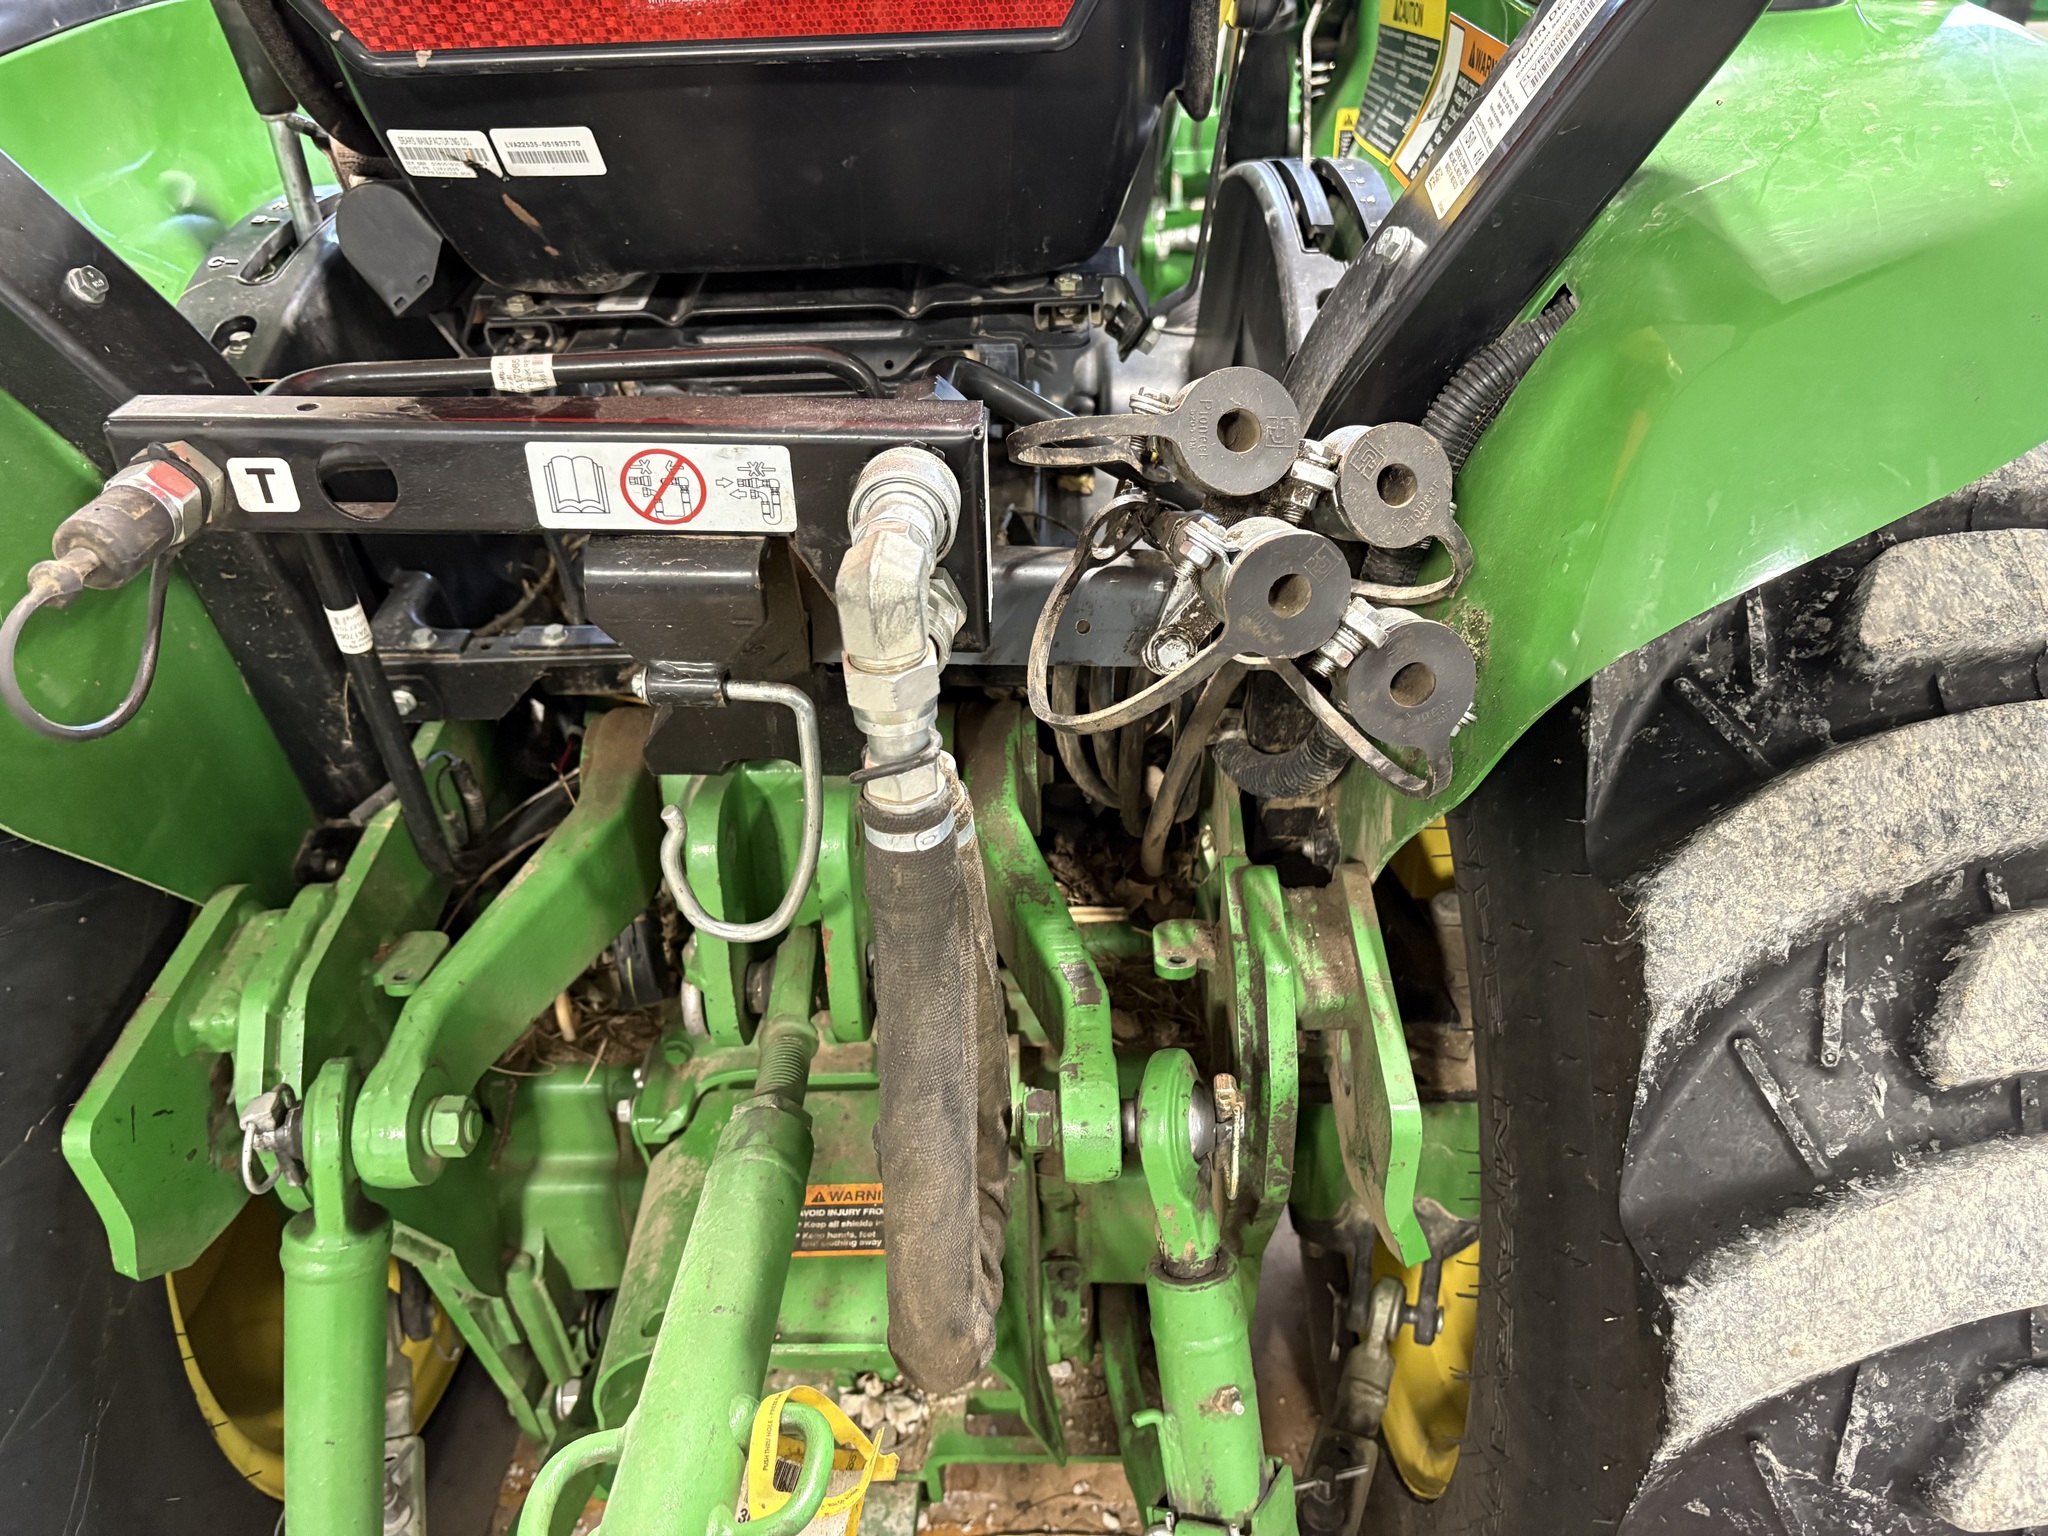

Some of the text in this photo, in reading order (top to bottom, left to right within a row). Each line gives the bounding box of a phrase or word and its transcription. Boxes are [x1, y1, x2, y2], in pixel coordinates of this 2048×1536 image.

[1516, 24, 1546, 69] JOHN
[1198, 399, 1213, 462] Pioneer
[244, 467, 276, 503] T
[1400, 480, 1441, 532] Pioneer
[827, 1208, 861, 1217] INJURY
[804, 1221, 826, 1229] Keep
[828, 1220, 840, 1228] all
[841, 1219, 873, 1228] shields
[859, 1239, 882, 1247] away
[766, 1419, 774, 1441] HOLE
[764, 1441, 772, 1458] THRU
[763, 1457, 771, 1471] PUSH
